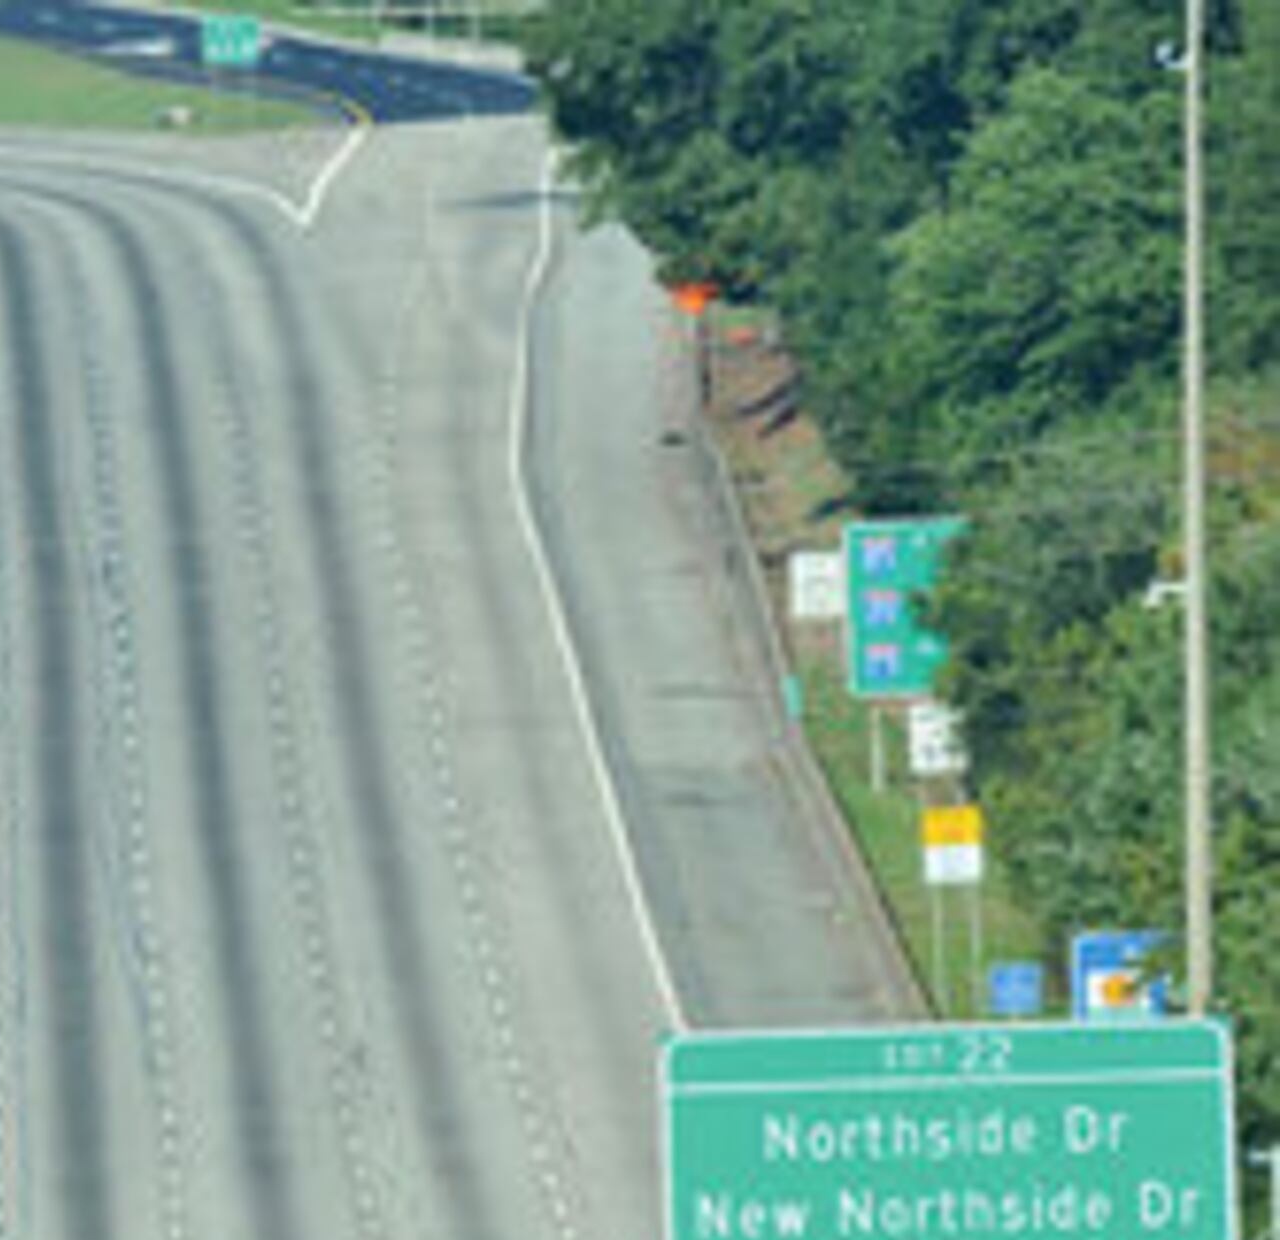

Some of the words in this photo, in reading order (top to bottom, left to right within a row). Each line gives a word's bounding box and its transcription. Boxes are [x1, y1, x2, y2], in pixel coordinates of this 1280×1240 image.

[763, 1110, 1036, 1162] Northside
[1065, 1104, 1129, 1154] Dr
[696, 1193, 809, 1239] New
[840, 1184, 1111, 1237] Northside
[1141, 1180, 1200, 1230] Dr
